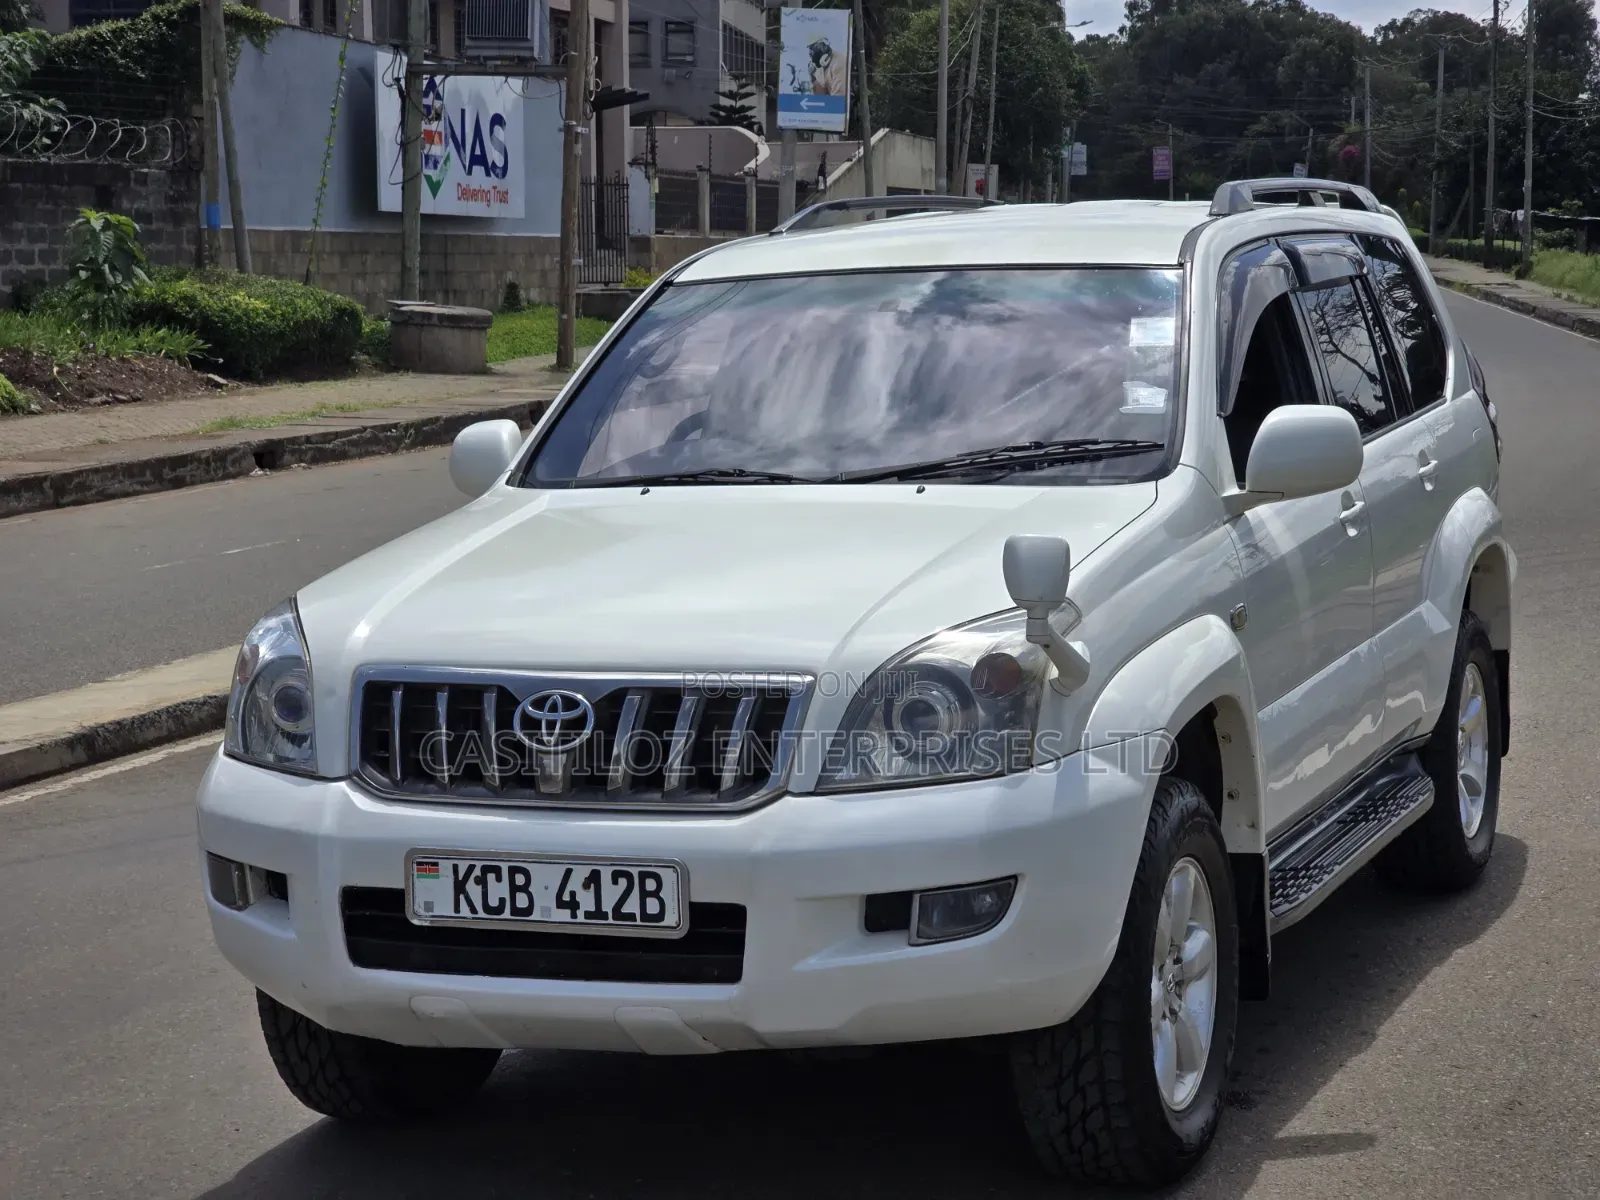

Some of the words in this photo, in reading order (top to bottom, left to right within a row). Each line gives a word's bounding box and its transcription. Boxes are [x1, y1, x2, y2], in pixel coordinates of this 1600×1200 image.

[457, 182, 491, 207] Delivering
[493, 186, 509, 204] Trust
[452, 863, 535, 917] KCB
[555, 867, 666, 924] 412B
